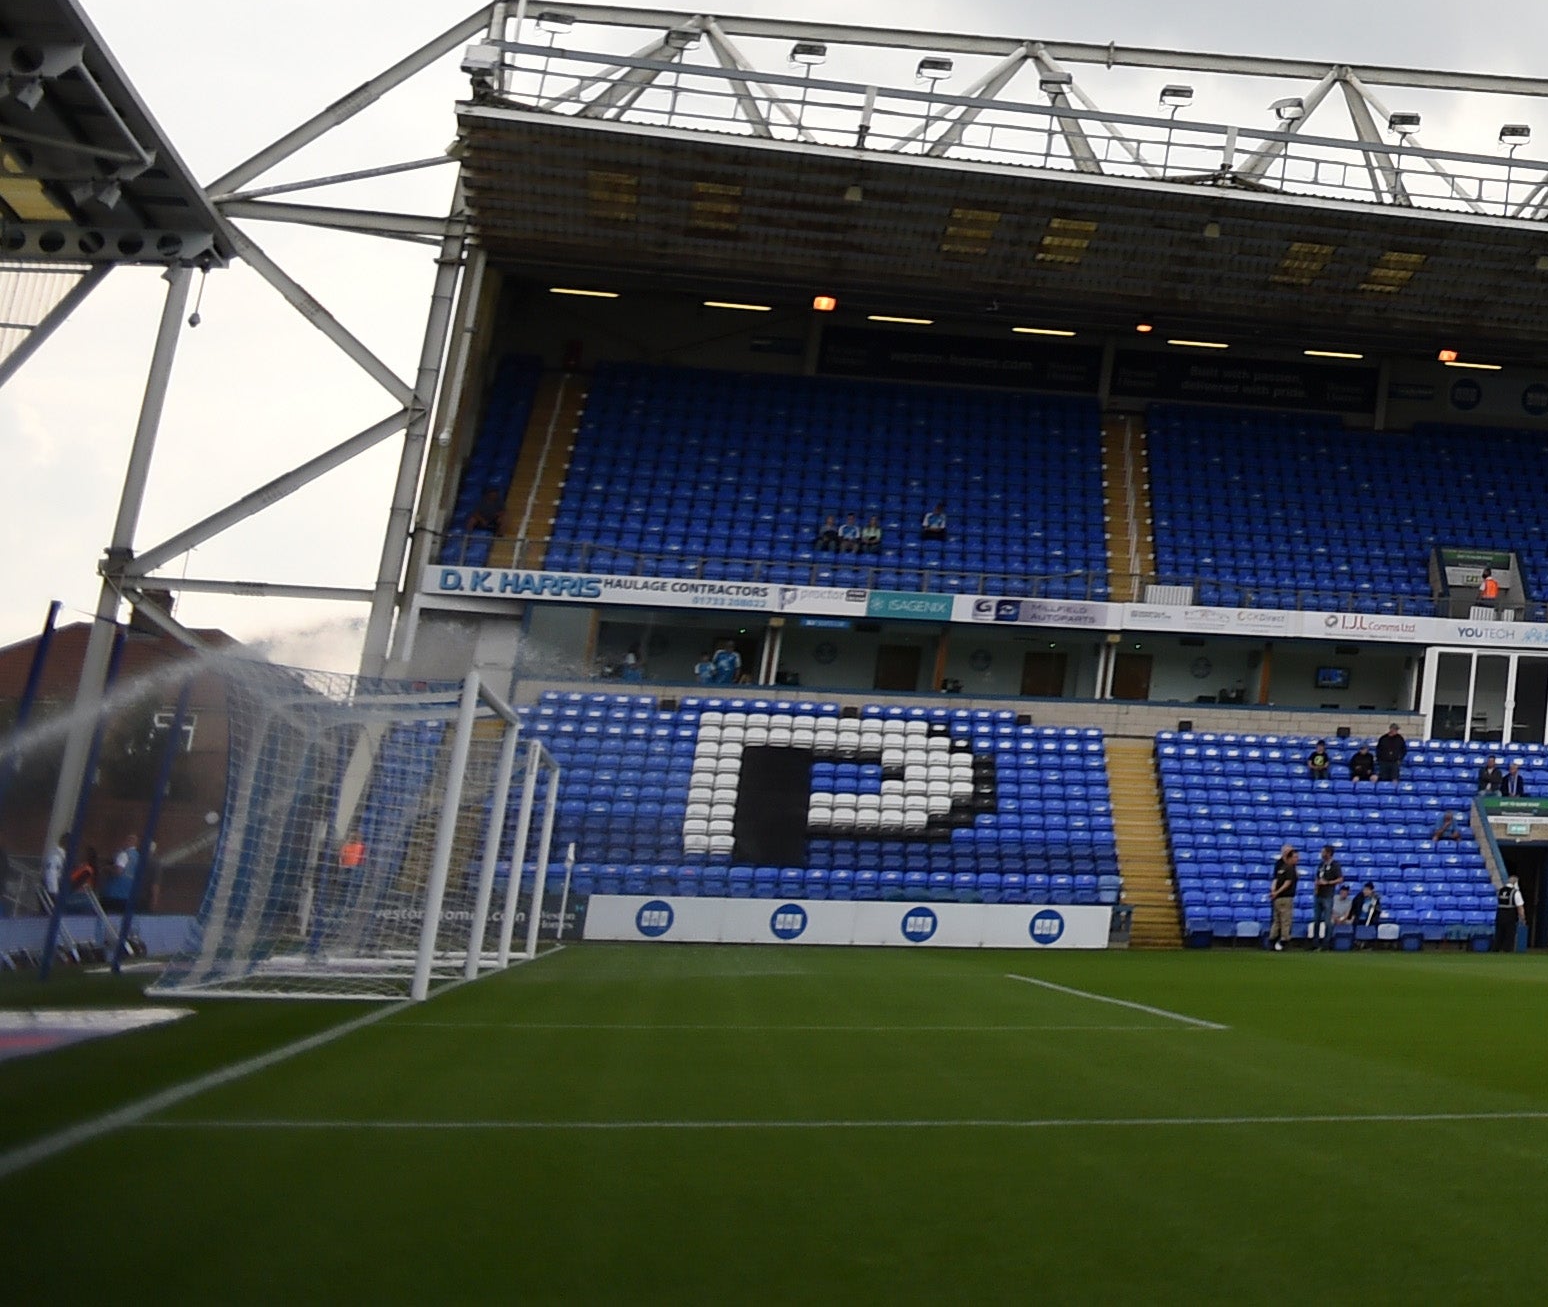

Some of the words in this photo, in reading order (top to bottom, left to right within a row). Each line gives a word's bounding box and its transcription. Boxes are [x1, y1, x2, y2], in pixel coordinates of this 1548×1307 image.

[500, 572, 603, 599] HARRIS
[602, 577, 669, 594] HAULAGE
[670, 581, 769, 598] CONTRACTORS
[888, 600, 947, 614] ISAGENIX
[1457, 626, 1515, 639] YOUTECH
